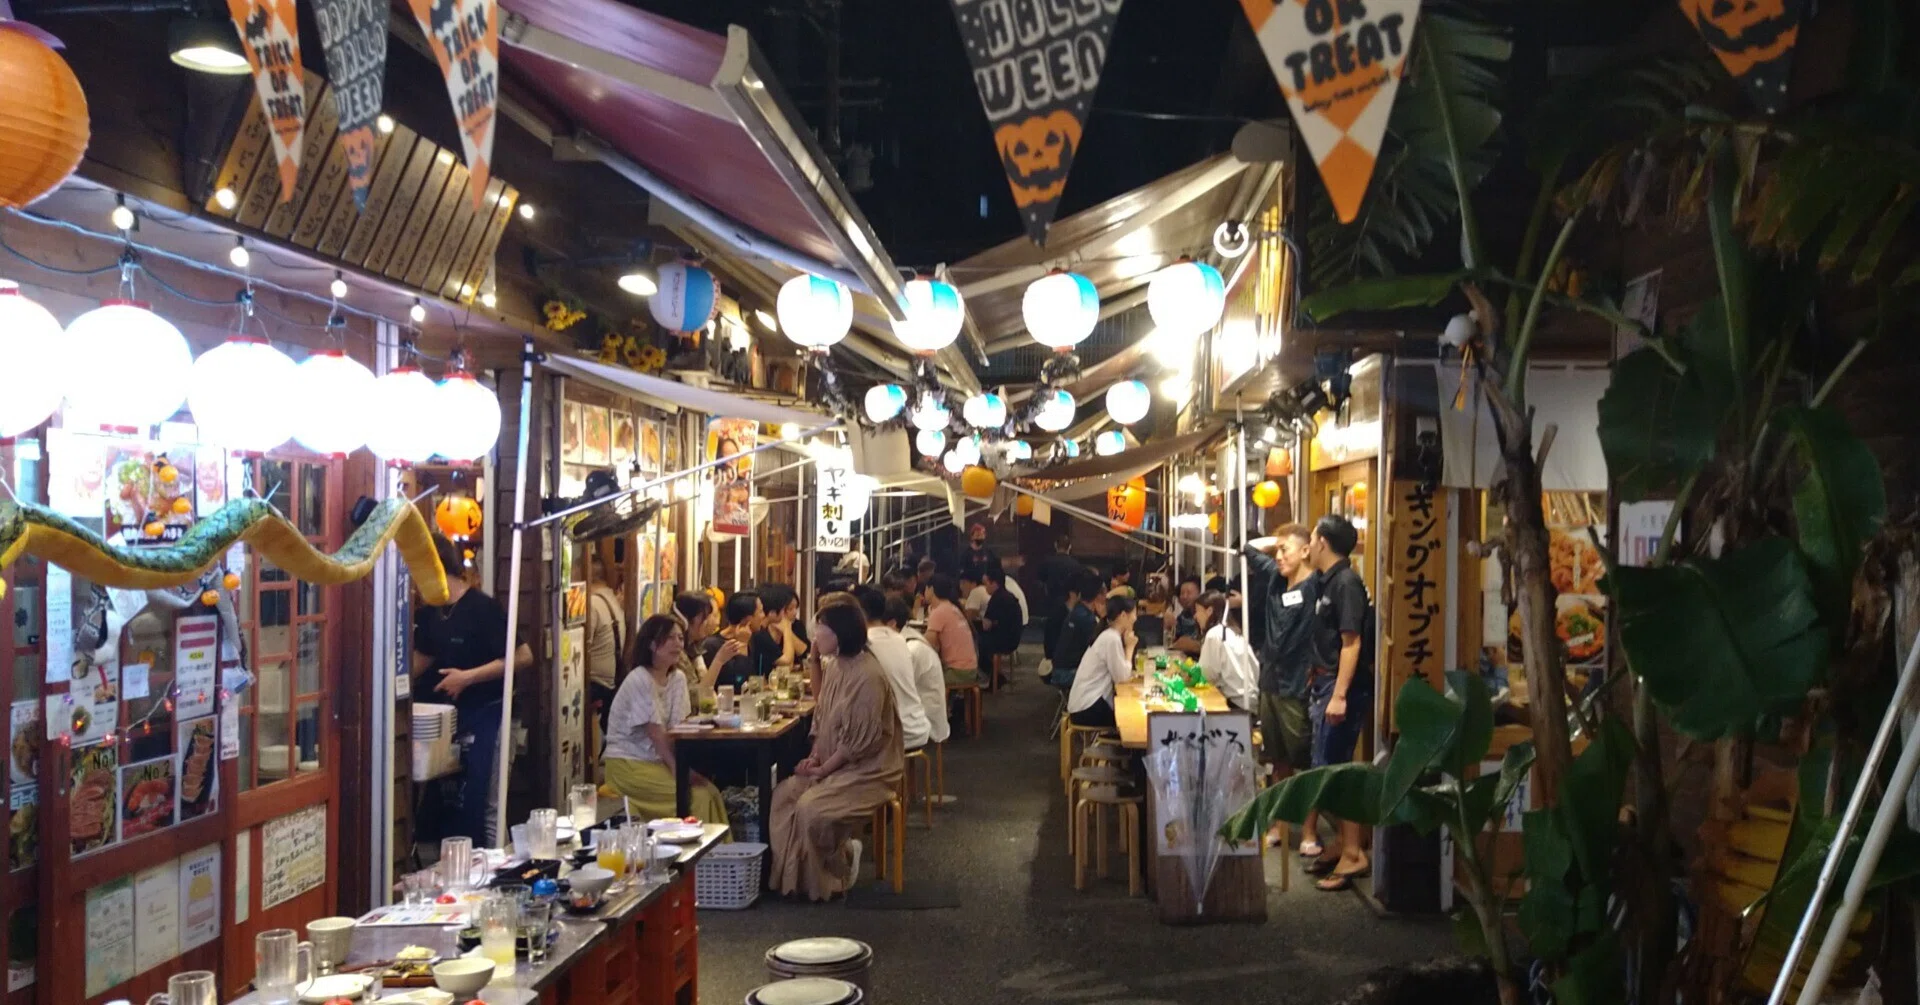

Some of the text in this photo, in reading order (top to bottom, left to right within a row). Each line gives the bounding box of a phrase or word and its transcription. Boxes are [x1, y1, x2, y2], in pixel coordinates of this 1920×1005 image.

[443, 3, 488, 64] TRICK
[981, 0, 1124, 58] HAL
[1284, 16, 1405, 93] TREAT
[459, 72, 495, 121] TREAT
[460, 48, 481, 85] OR
[973, 30, 1106, 122] WEEN
[824, 467, 846, 535] ヤギ刺し
